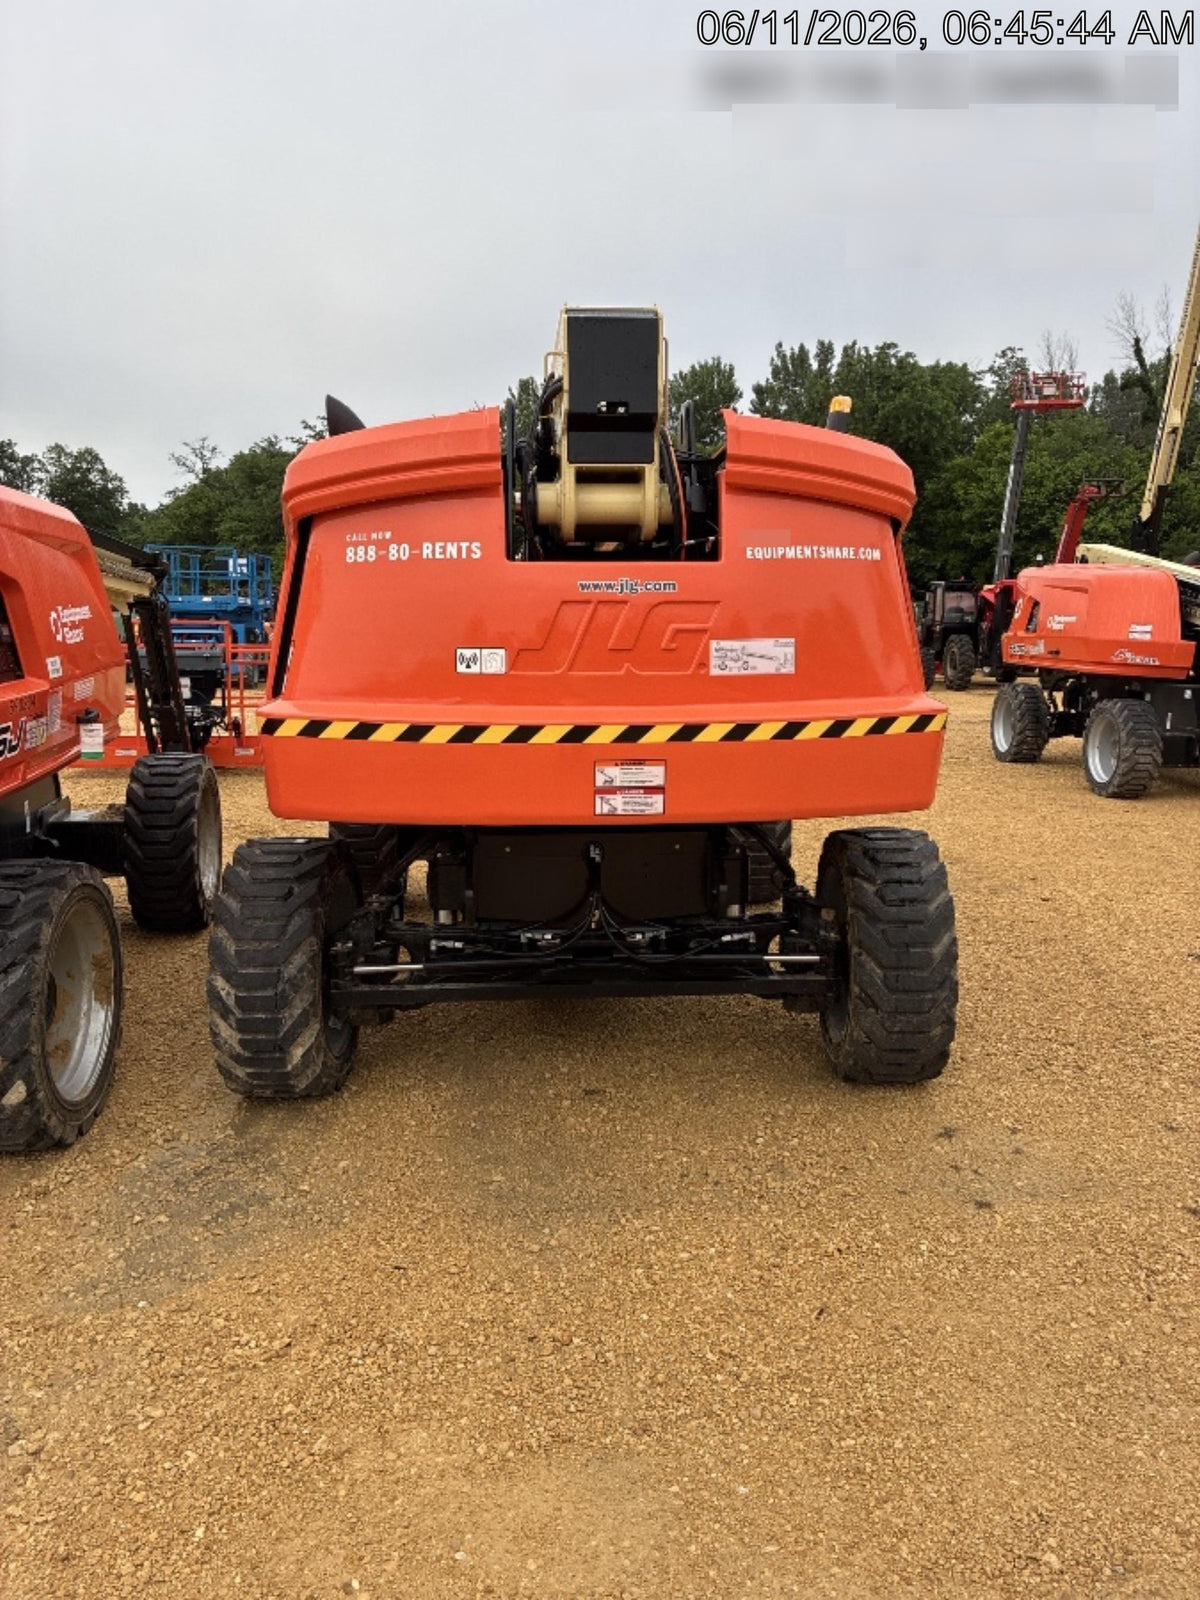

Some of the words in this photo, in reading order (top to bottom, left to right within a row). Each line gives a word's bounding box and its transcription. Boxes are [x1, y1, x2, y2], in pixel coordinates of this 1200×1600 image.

[345, 533, 368, 542] CALL
[371, 531, 392, 540] NOW
[345, 542, 482, 562] 888-80-RENTS
[746, 546, 881, 560] EQUIPMENTSHARE.COM
[578, 578, 677, 594] www.jlg.com
[509, 600, 722, 674] JLG
